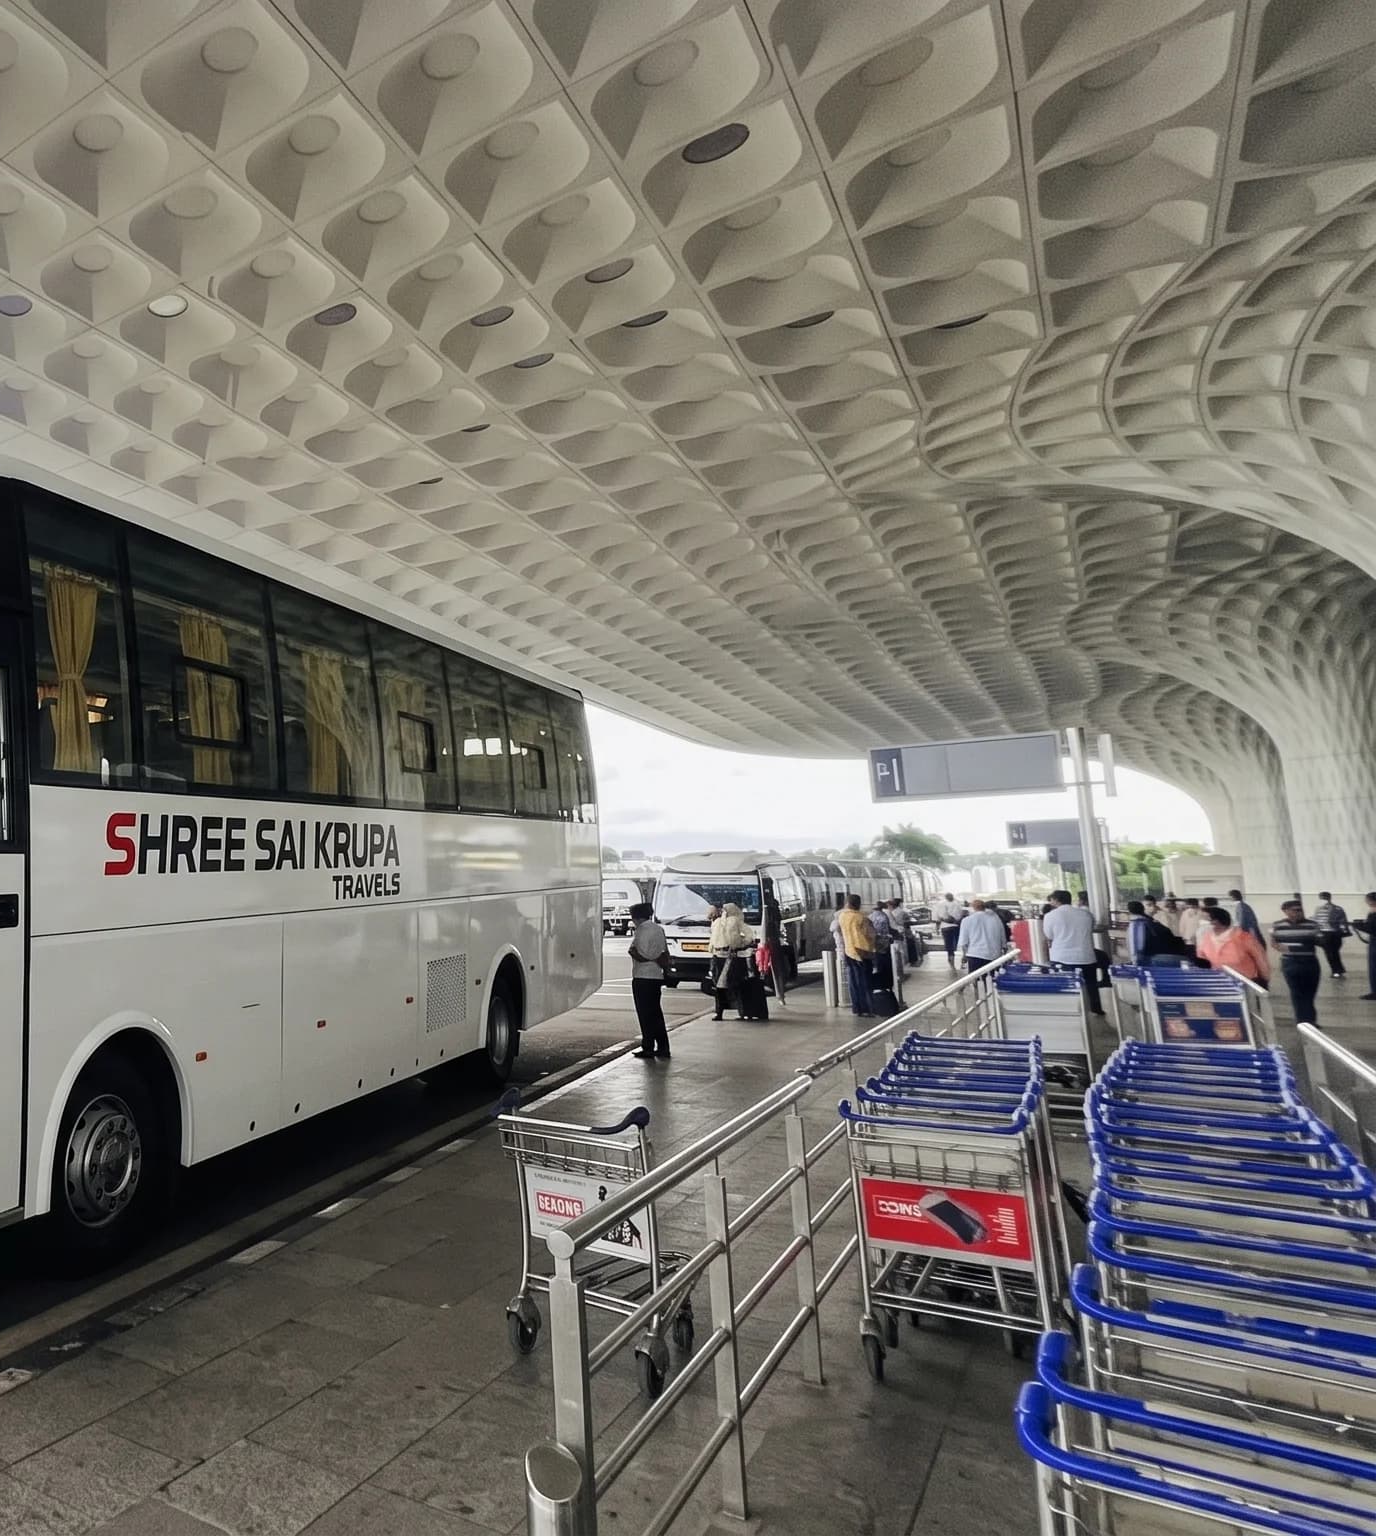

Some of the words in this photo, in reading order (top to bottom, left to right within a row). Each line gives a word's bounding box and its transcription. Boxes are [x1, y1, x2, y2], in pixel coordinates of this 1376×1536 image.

[104, 812, 247, 875] SHREE
[254, 818, 306, 871] SAI
[314, 821, 400, 869] KRUPA
[332, 872, 400, 900] TRAVELS
